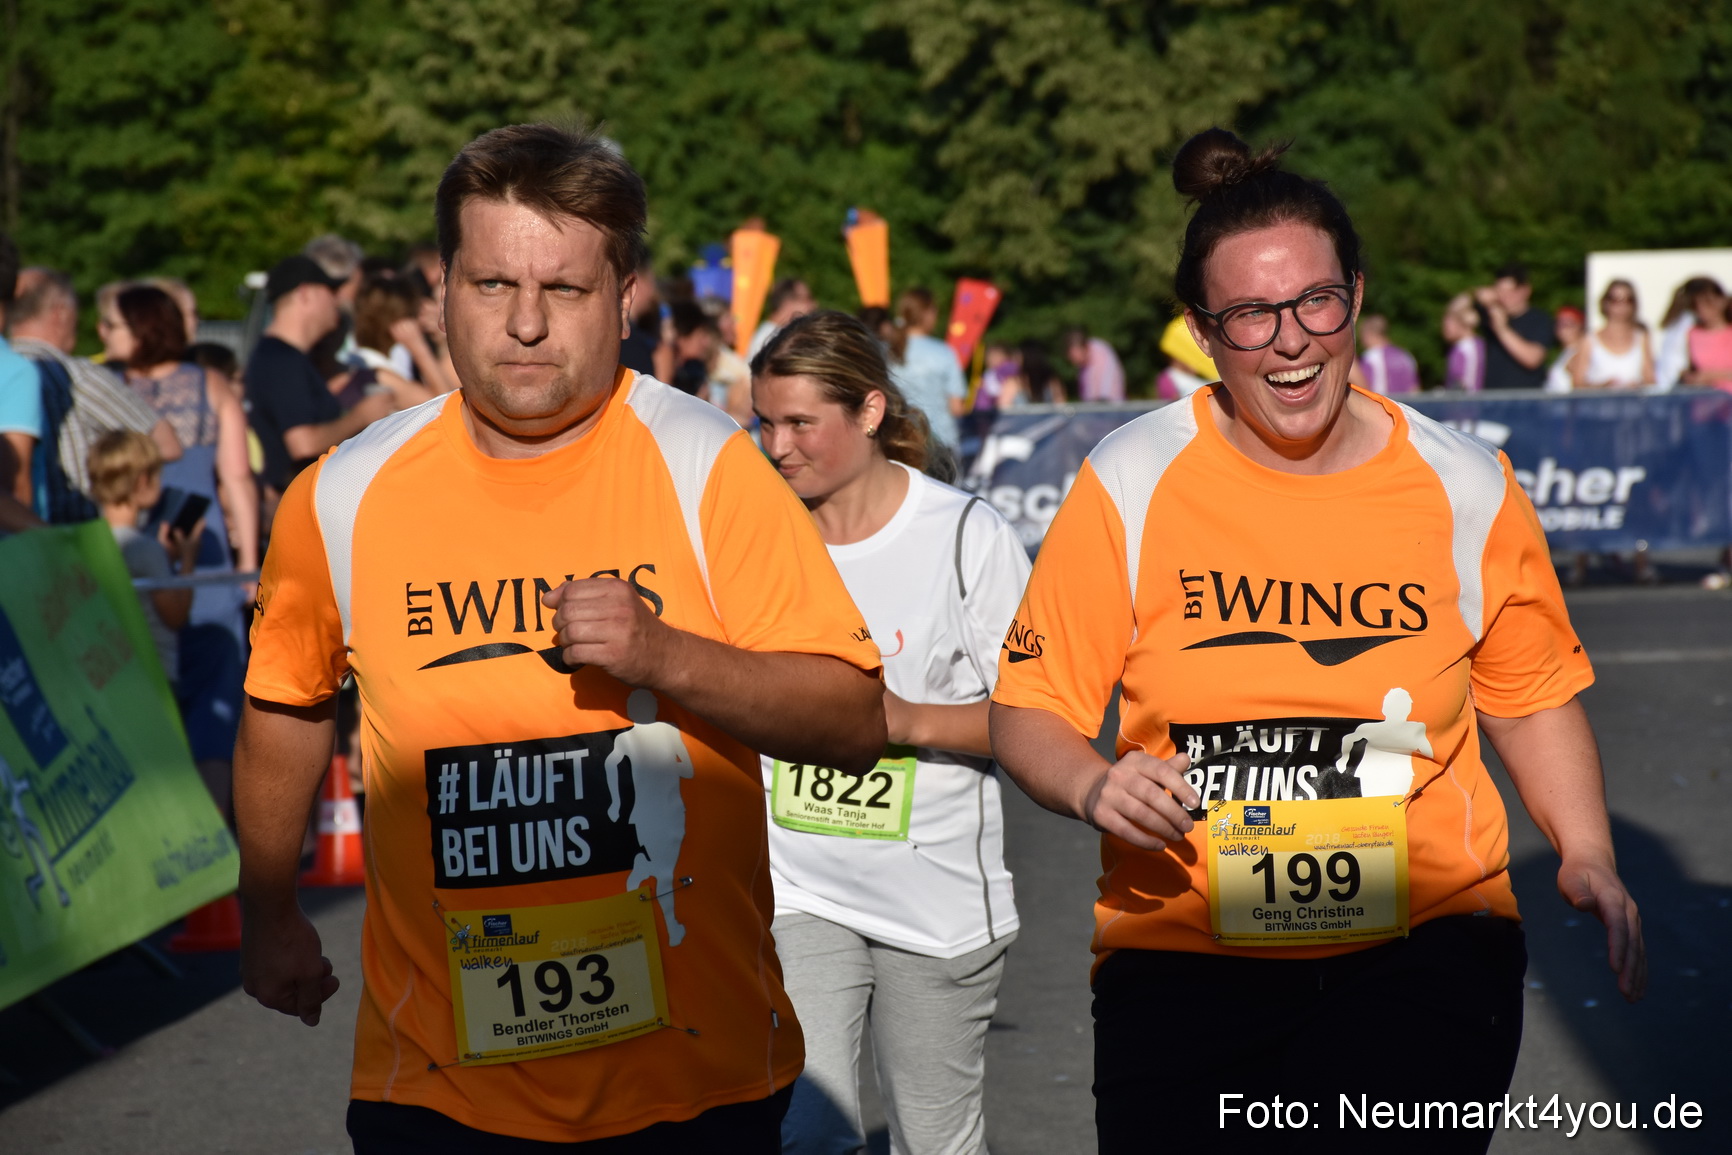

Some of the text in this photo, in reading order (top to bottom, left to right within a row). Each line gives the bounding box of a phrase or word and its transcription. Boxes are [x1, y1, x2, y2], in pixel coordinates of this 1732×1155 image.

[1537, 506, 1626, 532] OBILE
[406, 582, 433, 638] BIT
[1179, 568, 1429, 633] BIT WINGS
[1007, 618, 1046, 657] INGS
[788, 763, 894, 810] 1822
[786, 810, 830, 825] Seniorenstift
[845, 819, 870, 830] Tiroler
[871, 822, 886, 830] Hof
[804, 802, 867, 820] Waas Tanja
[1232, 823, 1297, 836] firmenlauf
[1305, 833, 1341, 845] 2018
[441, 815, 592, 879] BEI UNS
[1218, 842, 1269, 857] walken
[1252, 851, 1362, 904] 199
[1252, 905, 1365, 922] Geng Christina
[1264, 919, 1352, 932] BITWINGS GmbH
[472, 930, 540, 948] firmenlauf
[460, 954, 514, 970] walken
[496, 953, 616, 1018] 193
[493, 1002, 630, 1037] Bendler Thorsten
[517, 1028, 573, 1046] BITWINGS
[575, 1020, 609, 1037] GmbH
